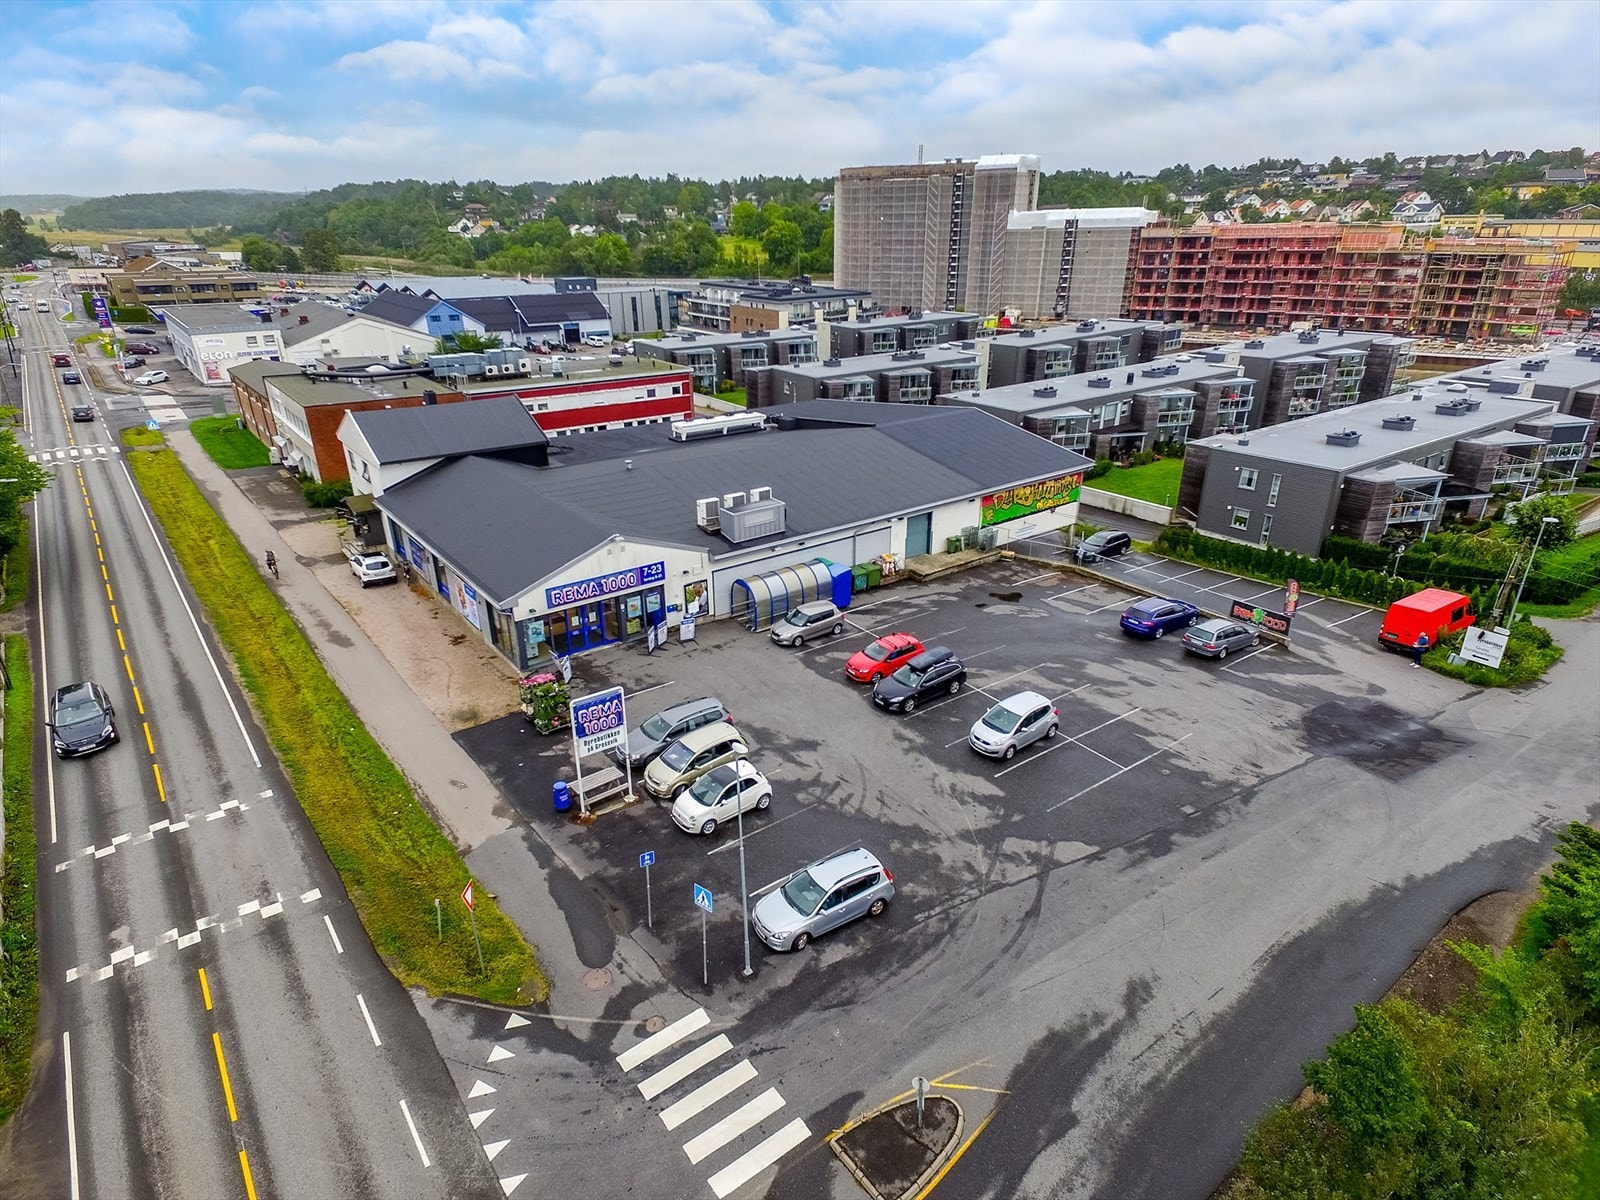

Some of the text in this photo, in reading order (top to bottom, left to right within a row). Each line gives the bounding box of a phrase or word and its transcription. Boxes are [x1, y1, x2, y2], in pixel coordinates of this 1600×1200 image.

[642, 564, 662, 576] 7-23
[551, 573, 636, 605] REMA 1000
[578, 699, 622, 724] REMA
[584, 714, 618, 735] 1000
